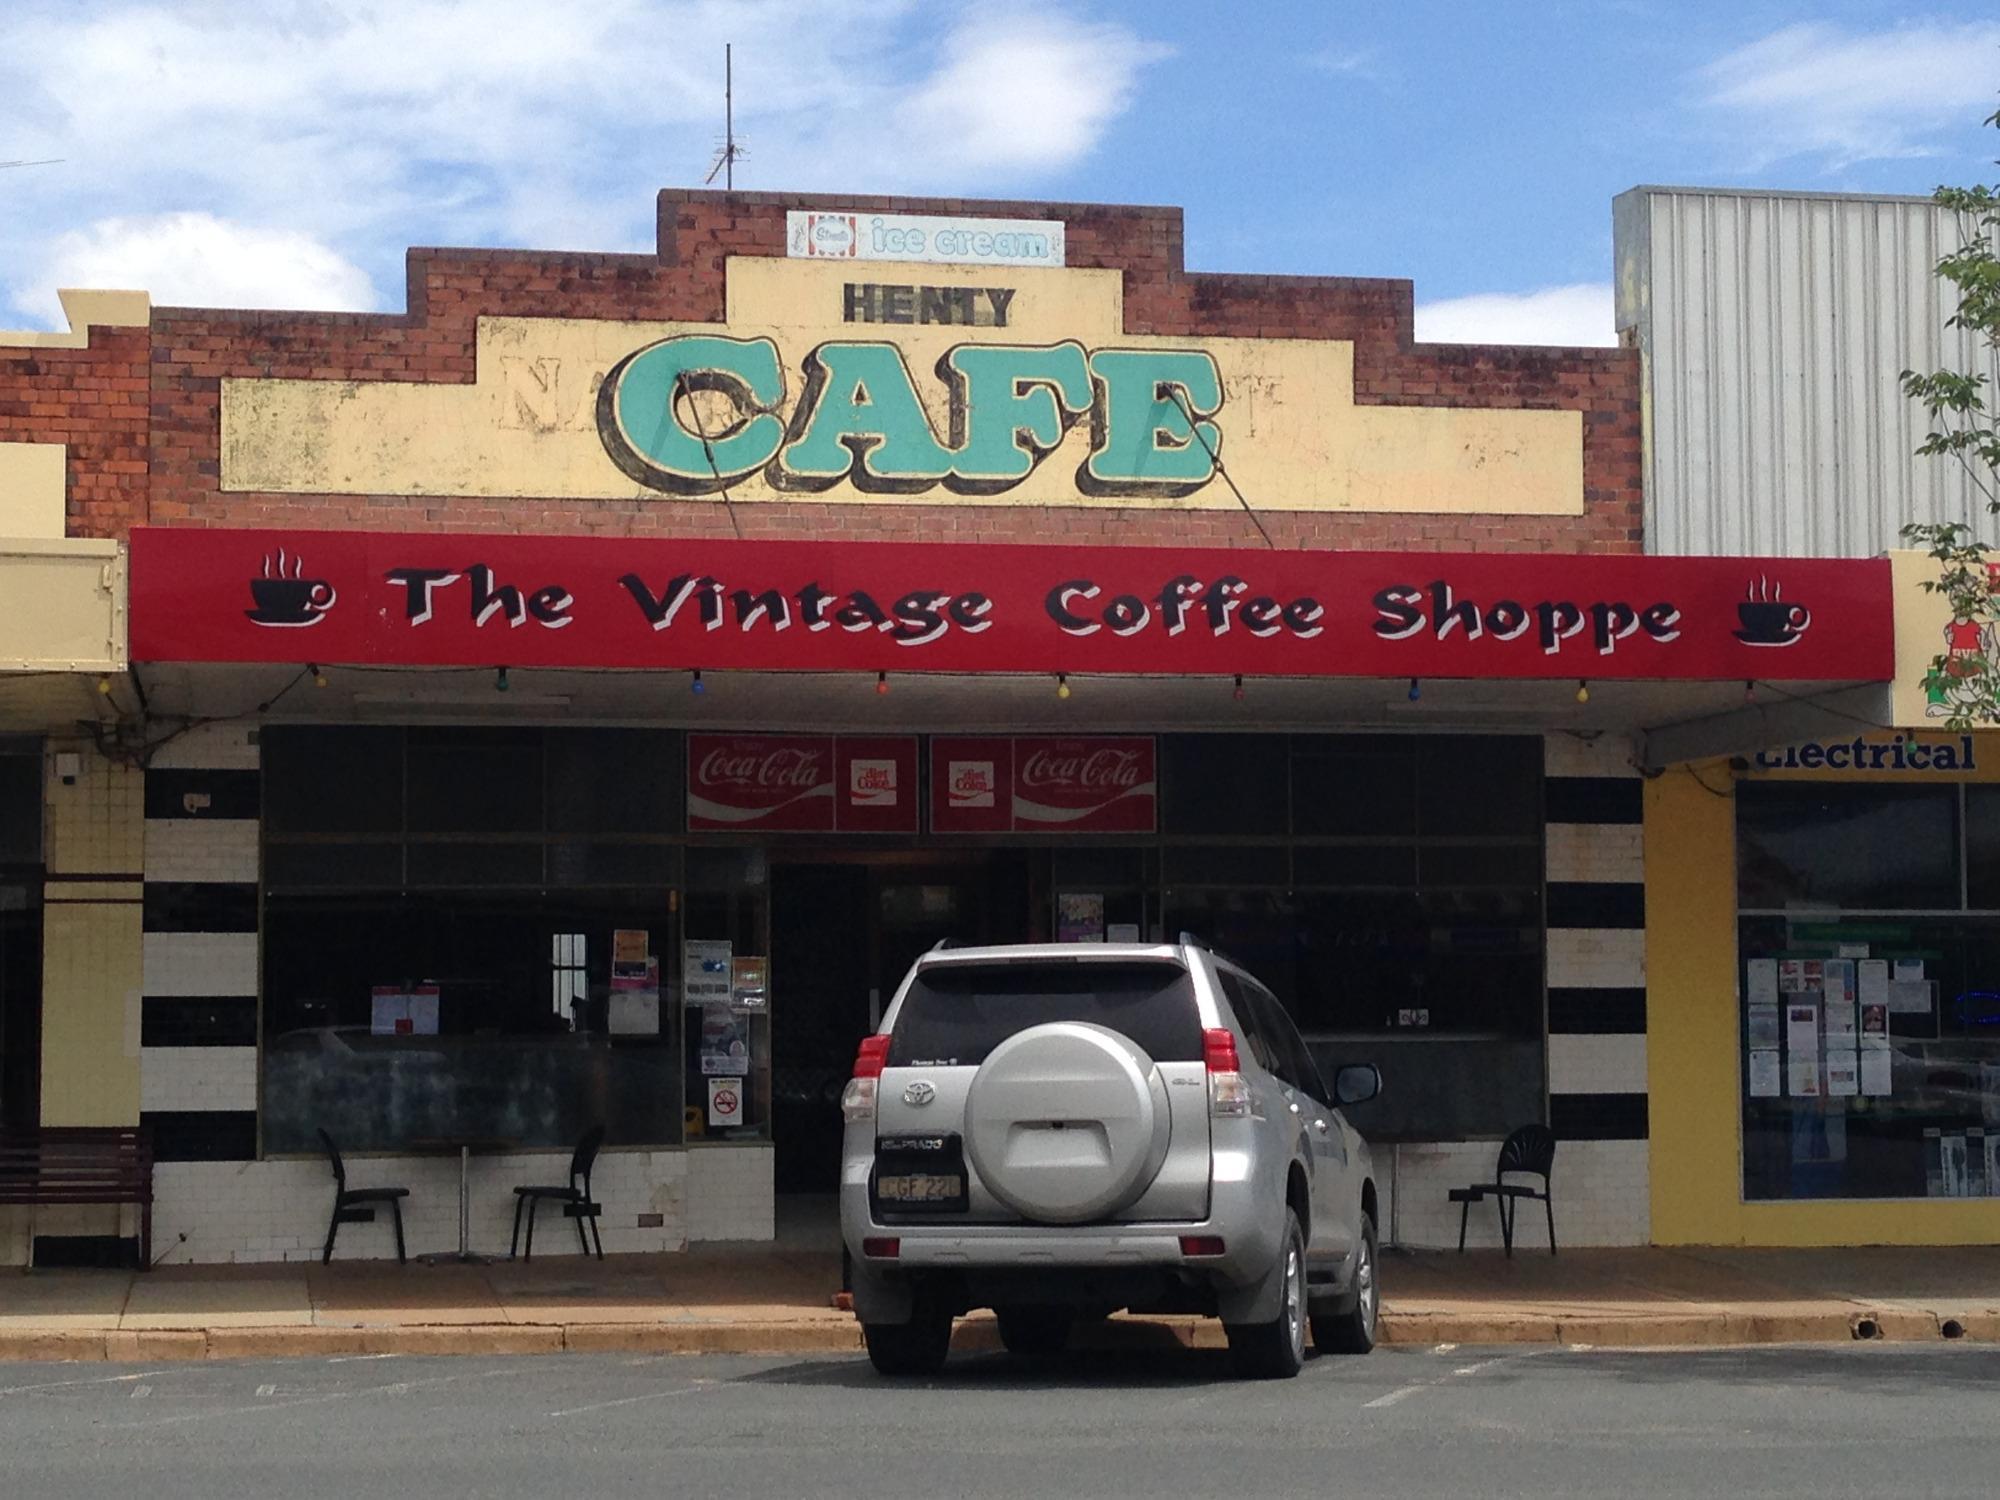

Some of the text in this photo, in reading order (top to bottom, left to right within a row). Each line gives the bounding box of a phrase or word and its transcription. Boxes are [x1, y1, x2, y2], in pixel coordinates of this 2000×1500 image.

[870, 217, 1049, 259] ice cream
[843, 283, 1017, 327] HENTY
[597, 334, 1223, 498] CAFE
[384, 564, 1681, 655] The Vintage Coffee Shoppe
